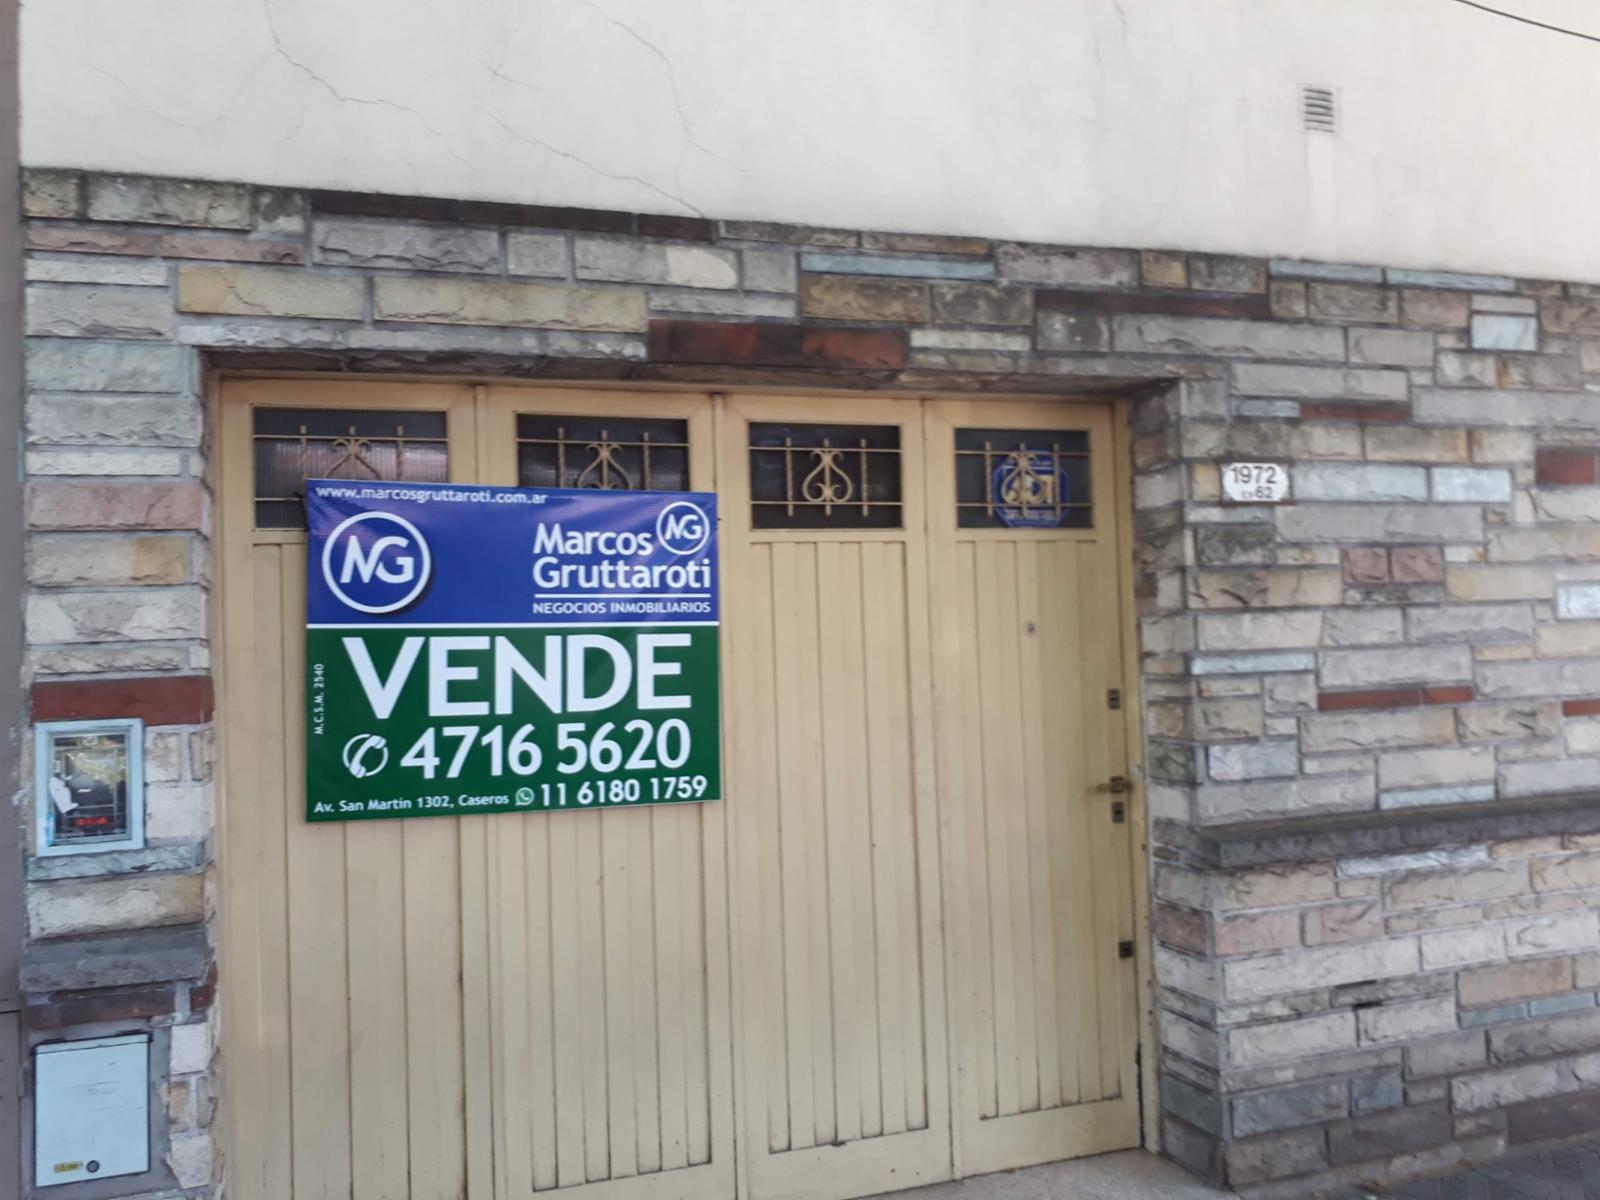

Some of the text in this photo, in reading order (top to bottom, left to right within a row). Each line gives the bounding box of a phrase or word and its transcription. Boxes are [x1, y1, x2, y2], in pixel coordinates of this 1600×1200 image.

[1231, 465, 1277, 484] 1972
[315, 486, 548, 504] www.marcosgruttaroti.com.ar
[1255, 486, 1273, 498] 62
[533, 522, 653, 555] Marcos
[533, 556, 711, 588] Gruttaroti
[533, 601, 711, 614] NEGOCIOS INMOBILIARIOS
[342, 633, 692, 719] VENDE
[313, 663, 325, 735] M.C.S.M. 2540
[400, 718, 691, 779] 4716 5620
[314, 801, 335, 813] Av.
[339, 799, 364, 812] San
[417, 795, 454, 808] 1302,
[458, 793, 510, 807] Caseros
[541, 775, 708, 806] 11 6180 1759
